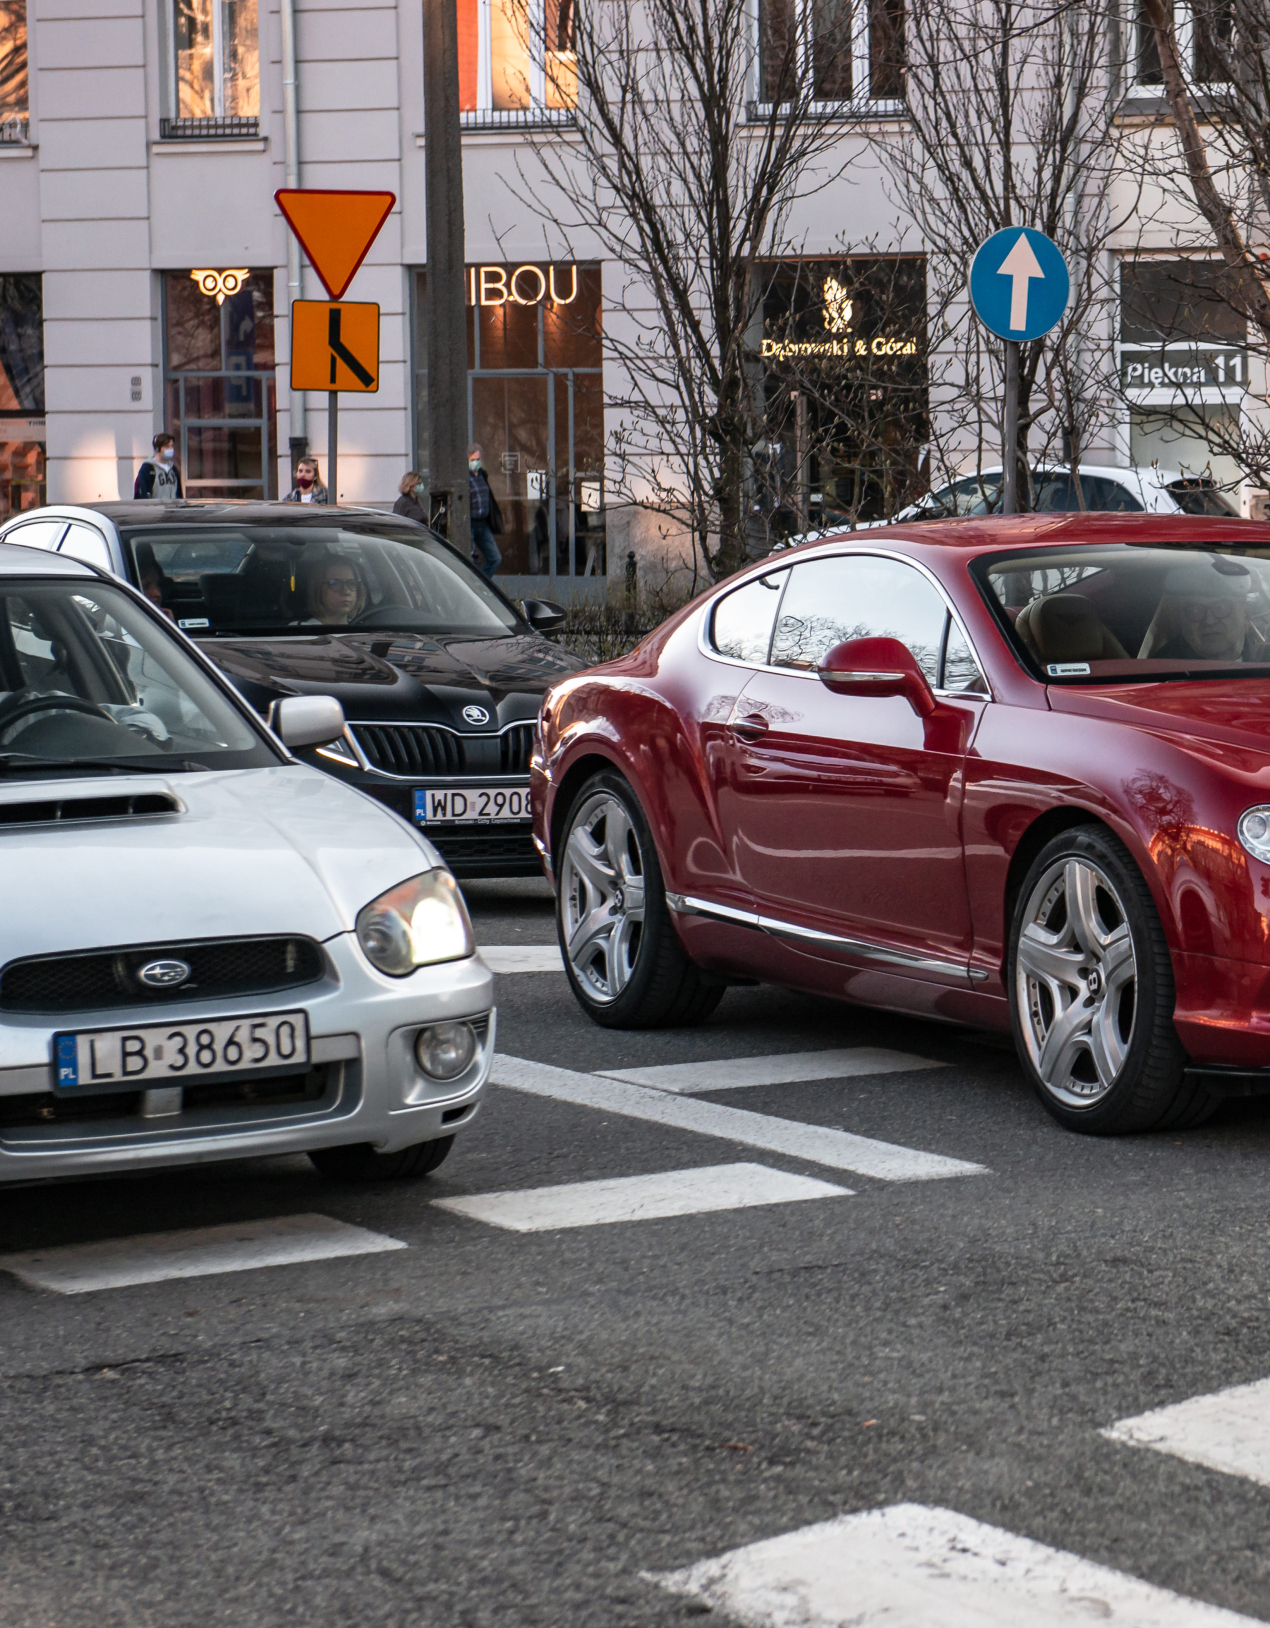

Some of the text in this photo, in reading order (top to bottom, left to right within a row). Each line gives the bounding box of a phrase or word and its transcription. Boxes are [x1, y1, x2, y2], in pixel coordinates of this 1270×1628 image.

[854, 339, 868, 356] &
[1127, 354, 1243, 388] Piękna 11
[431, 793, 468, 818] WD
[59, 1020, 297, 1080] PL LB 38650
